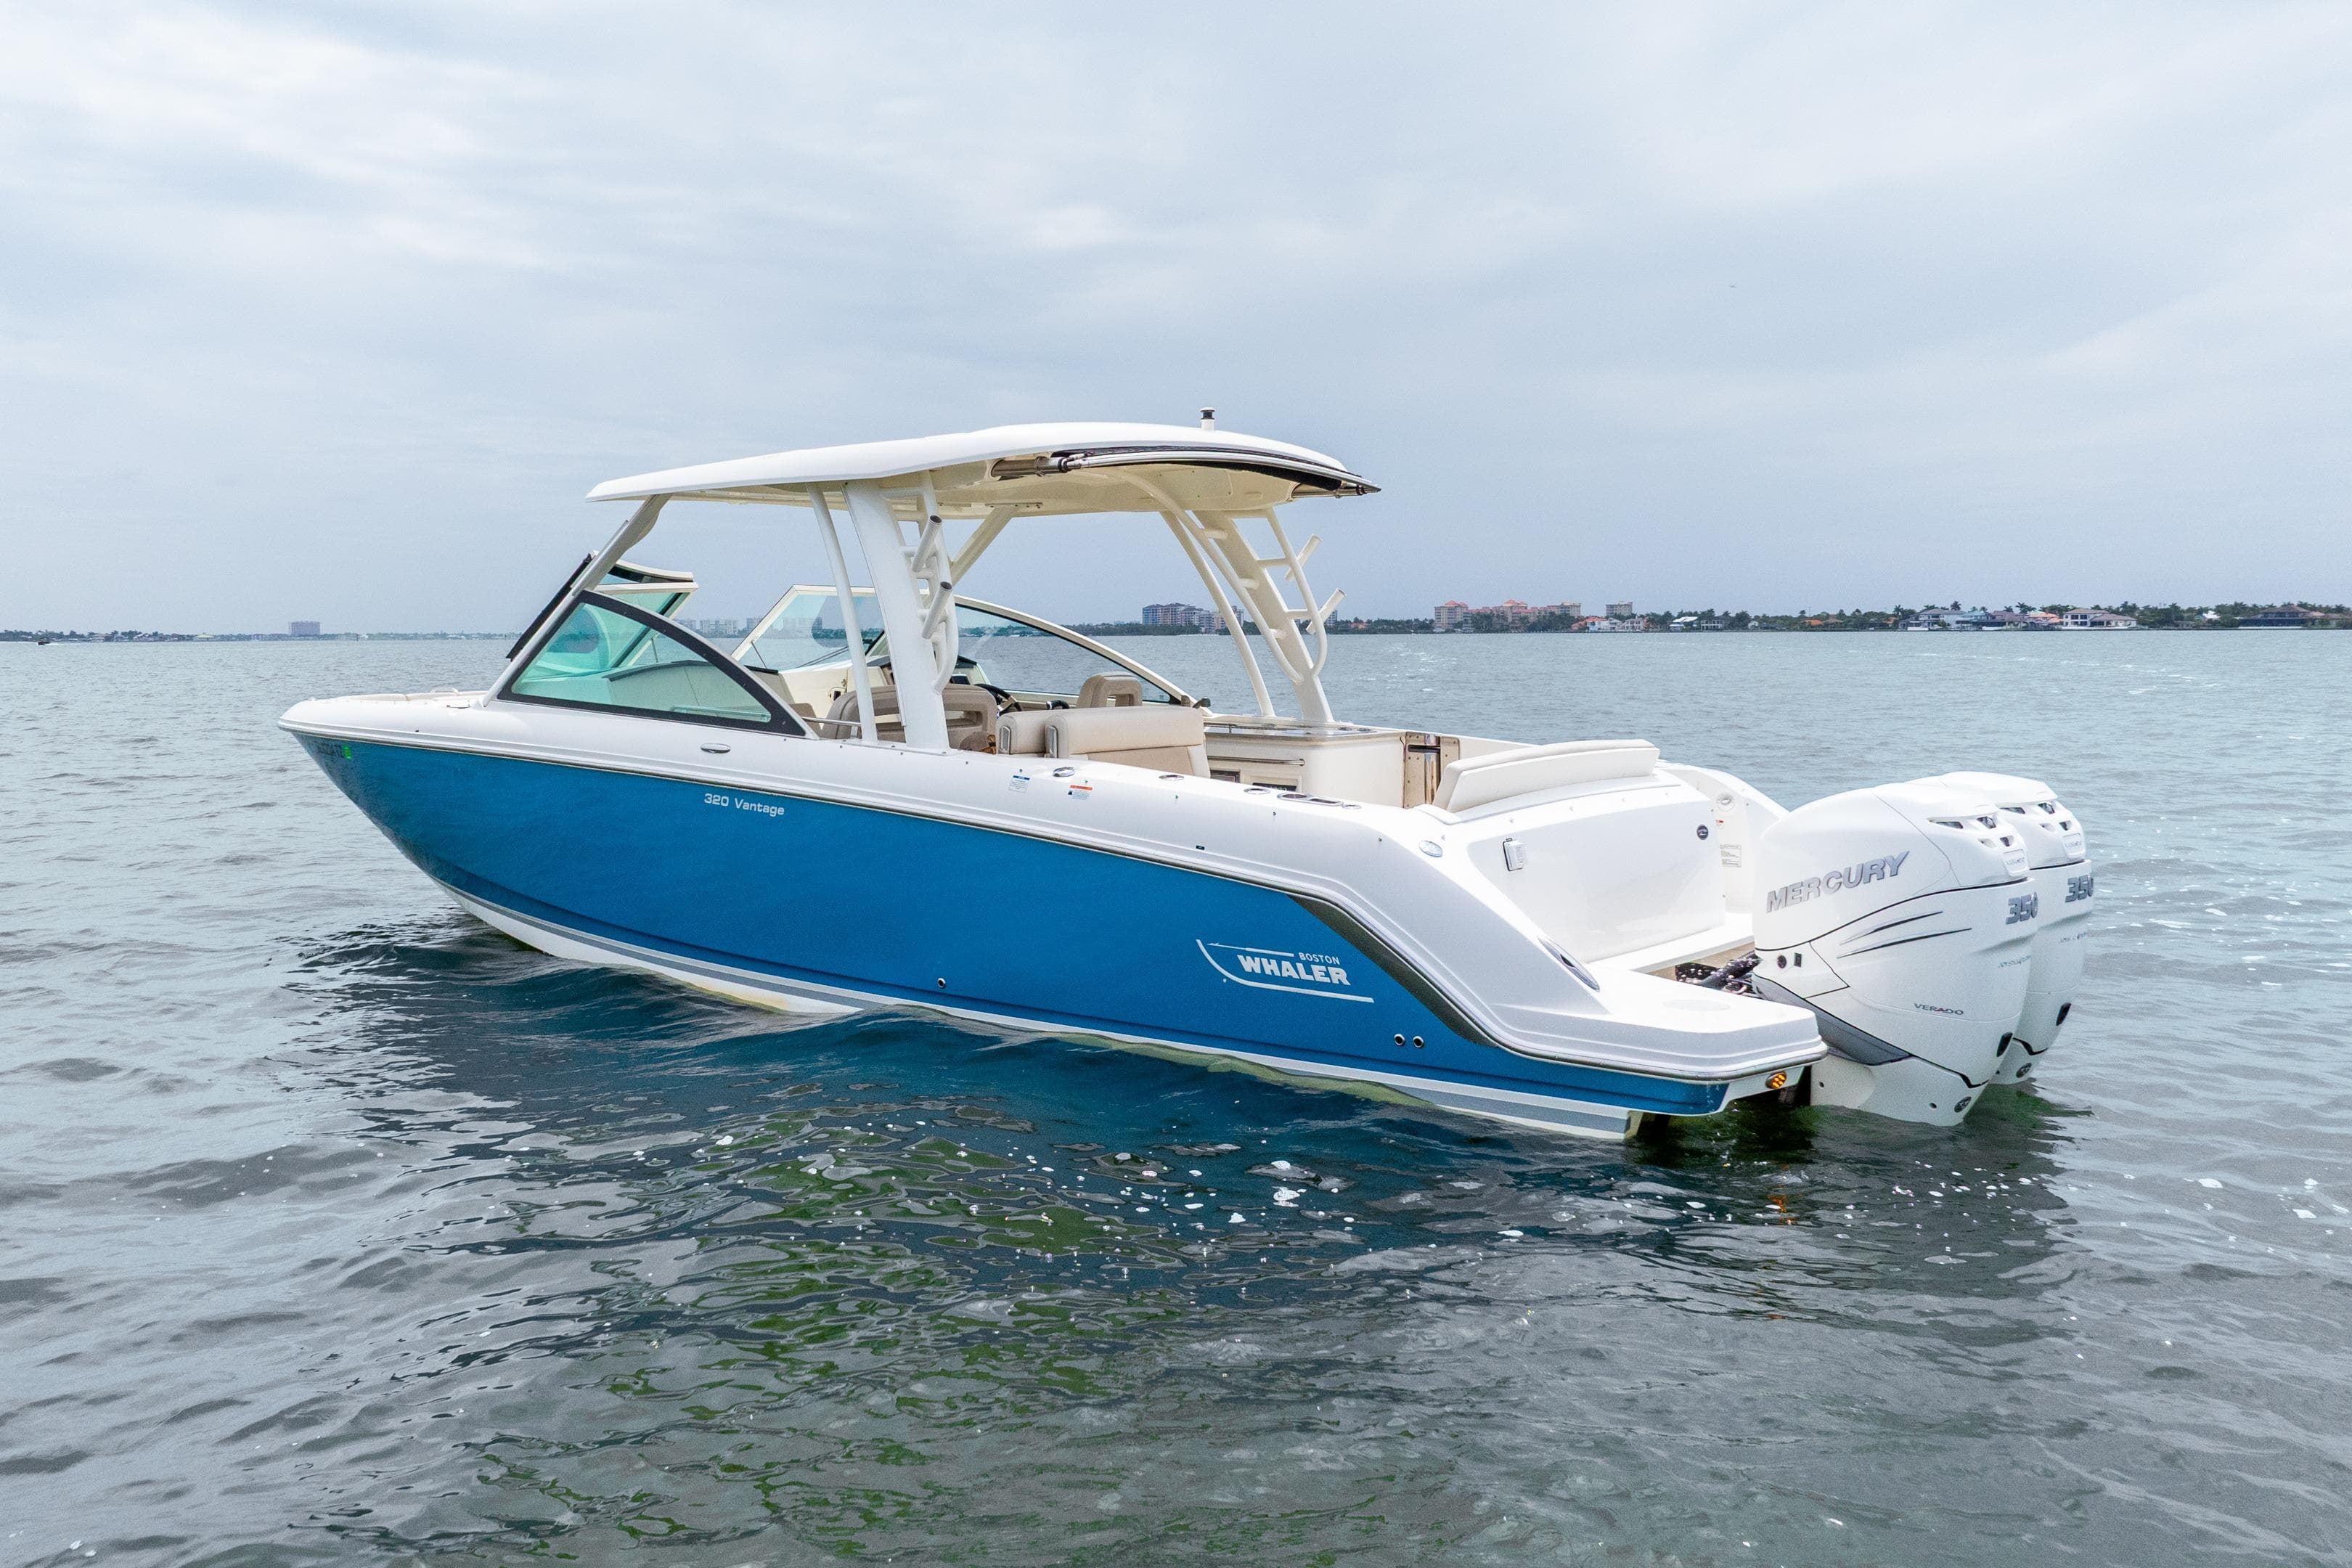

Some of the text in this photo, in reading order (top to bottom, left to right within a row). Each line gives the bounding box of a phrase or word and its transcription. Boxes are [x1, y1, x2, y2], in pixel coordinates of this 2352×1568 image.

[704, 793, 785, 817] 320 Vantage
[1766, 851, 1910, 913] MERCURY
[2065, 875, 2094, 903] 350
[2005, 891, 2038, 925] 350
[1237, 955, 1351, 986] WHALER
[1298, 952, 1340, 965] BOSTON
[1914, 1003, 1964, 1016] VERADO
